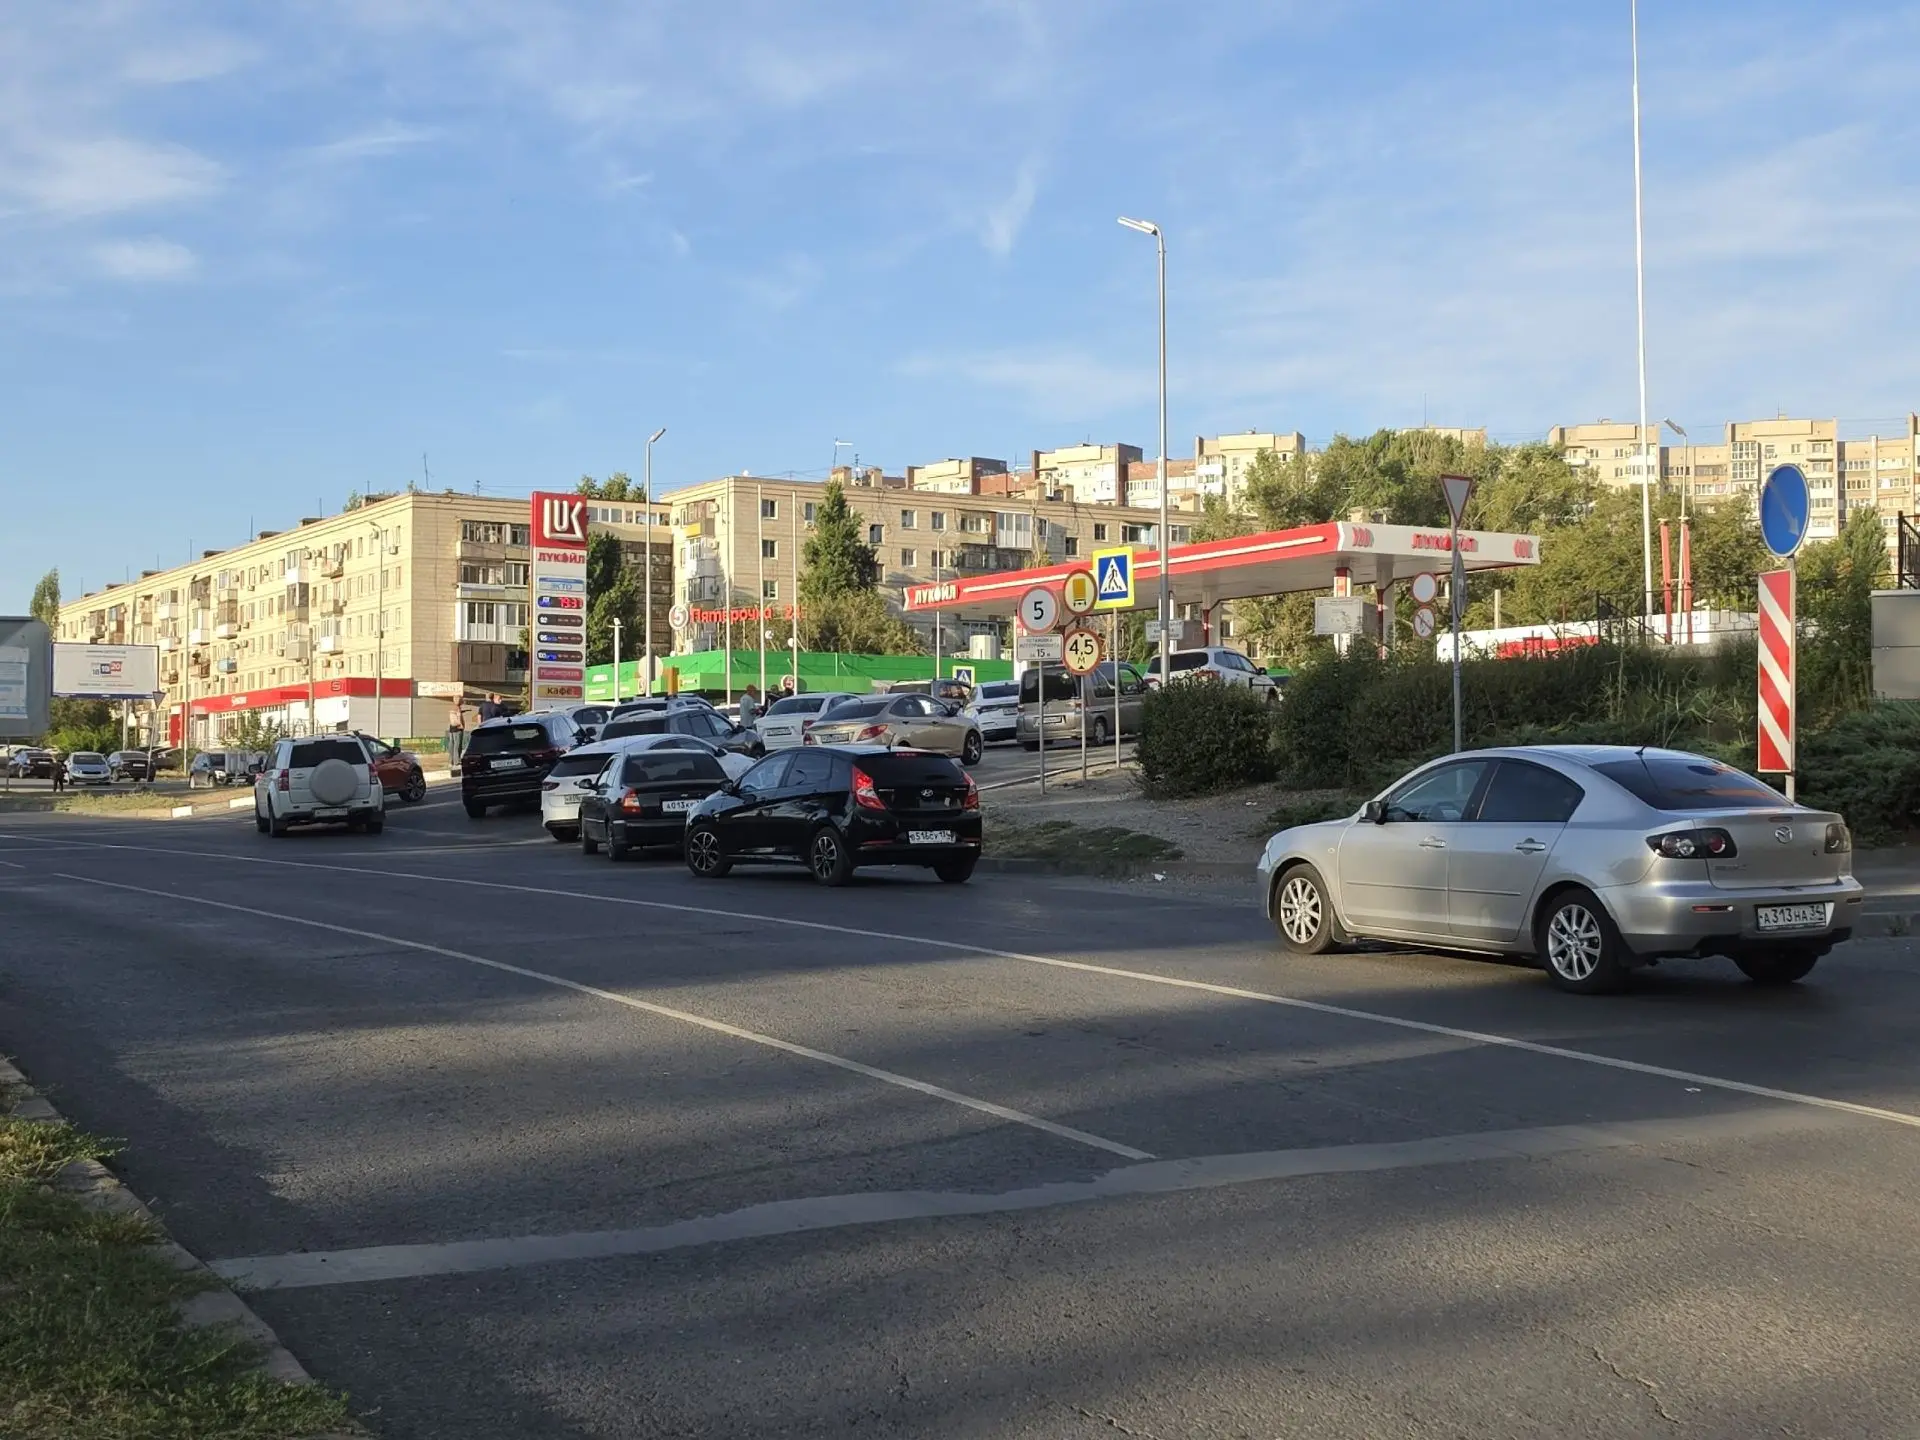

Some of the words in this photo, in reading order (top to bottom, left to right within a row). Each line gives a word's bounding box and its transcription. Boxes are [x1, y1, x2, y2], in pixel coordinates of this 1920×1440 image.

[538, 552, 585, 564] ЛУКОЙЛ
[914, 583, 956, 604] ЛУКОЙЛ
[1033, 600, 1044, 620] 5
[1037, 649, 1046, 658] 15
[1069, 639, 1094, 656] 4,5
